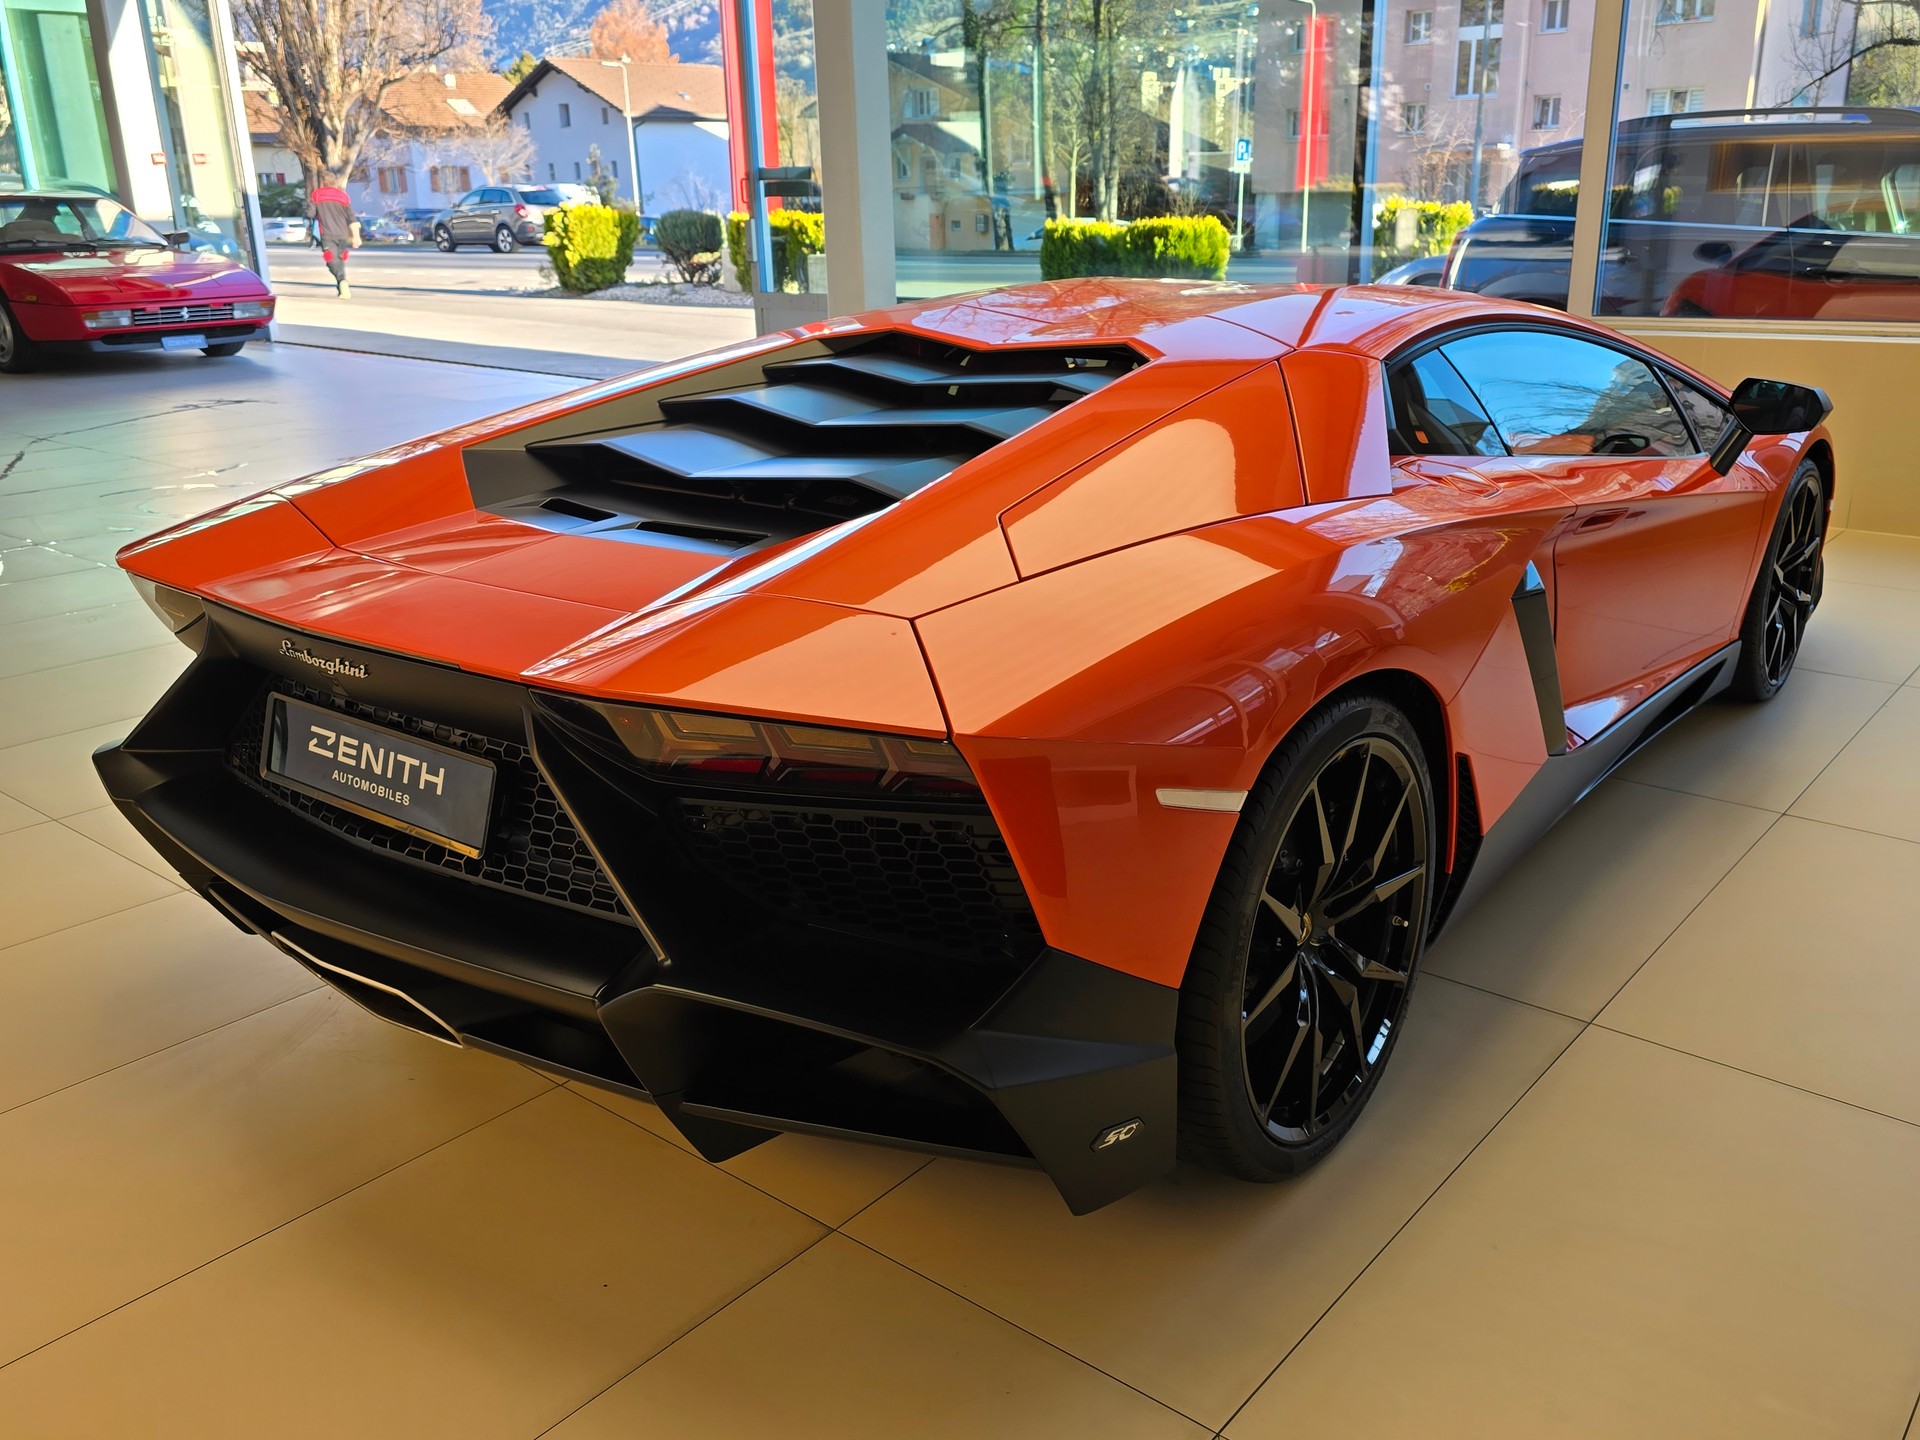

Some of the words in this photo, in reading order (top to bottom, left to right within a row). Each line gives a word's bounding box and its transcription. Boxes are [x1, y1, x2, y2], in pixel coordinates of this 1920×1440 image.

[279, 638, 368, 679] Lamborghini
[308, 725, 445, 796] ZENITH
[331, 769, 410, 806] AUTOMOBILES
